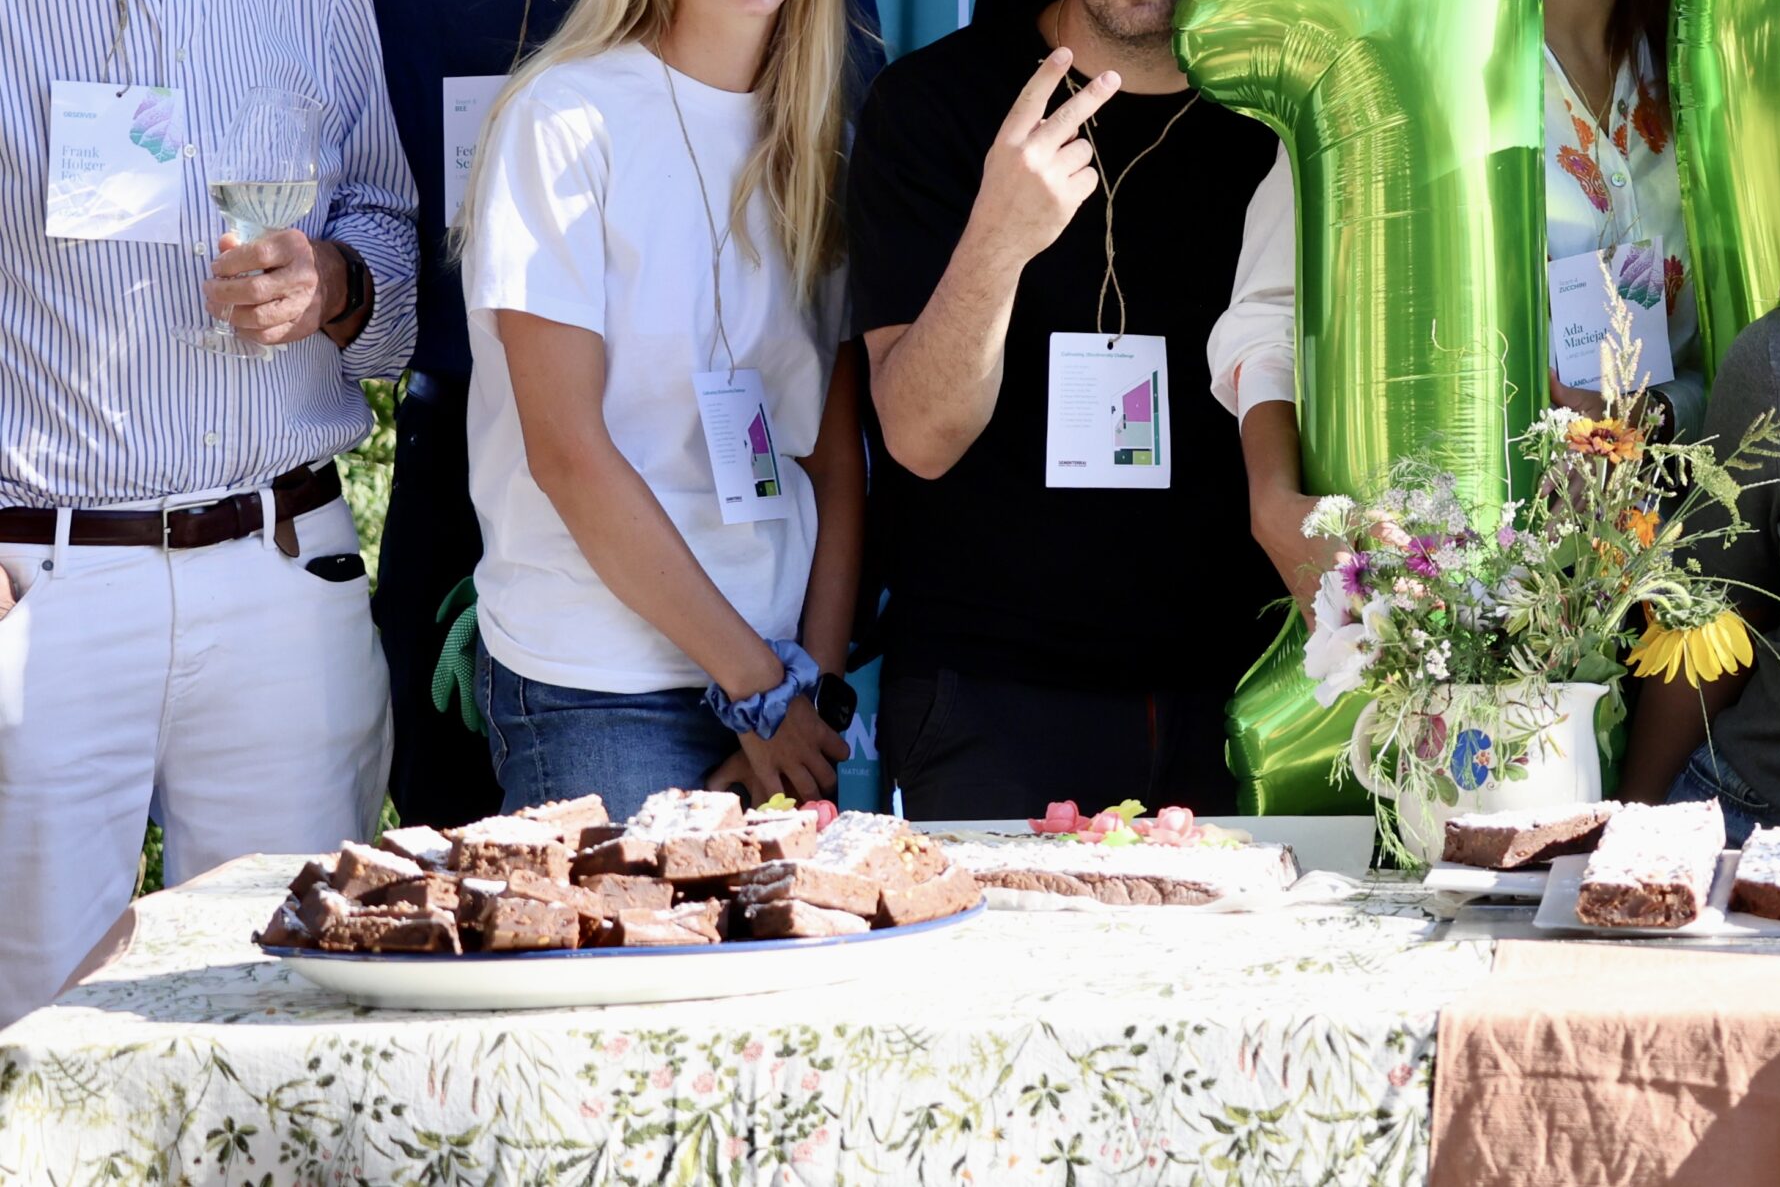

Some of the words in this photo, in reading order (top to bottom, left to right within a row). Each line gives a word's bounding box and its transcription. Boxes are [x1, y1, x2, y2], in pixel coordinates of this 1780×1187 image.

[62, 145, 100, 158] Frank
[61, 158, 106, 172] Holger
[1563, 323, 1584, 337] Ada
